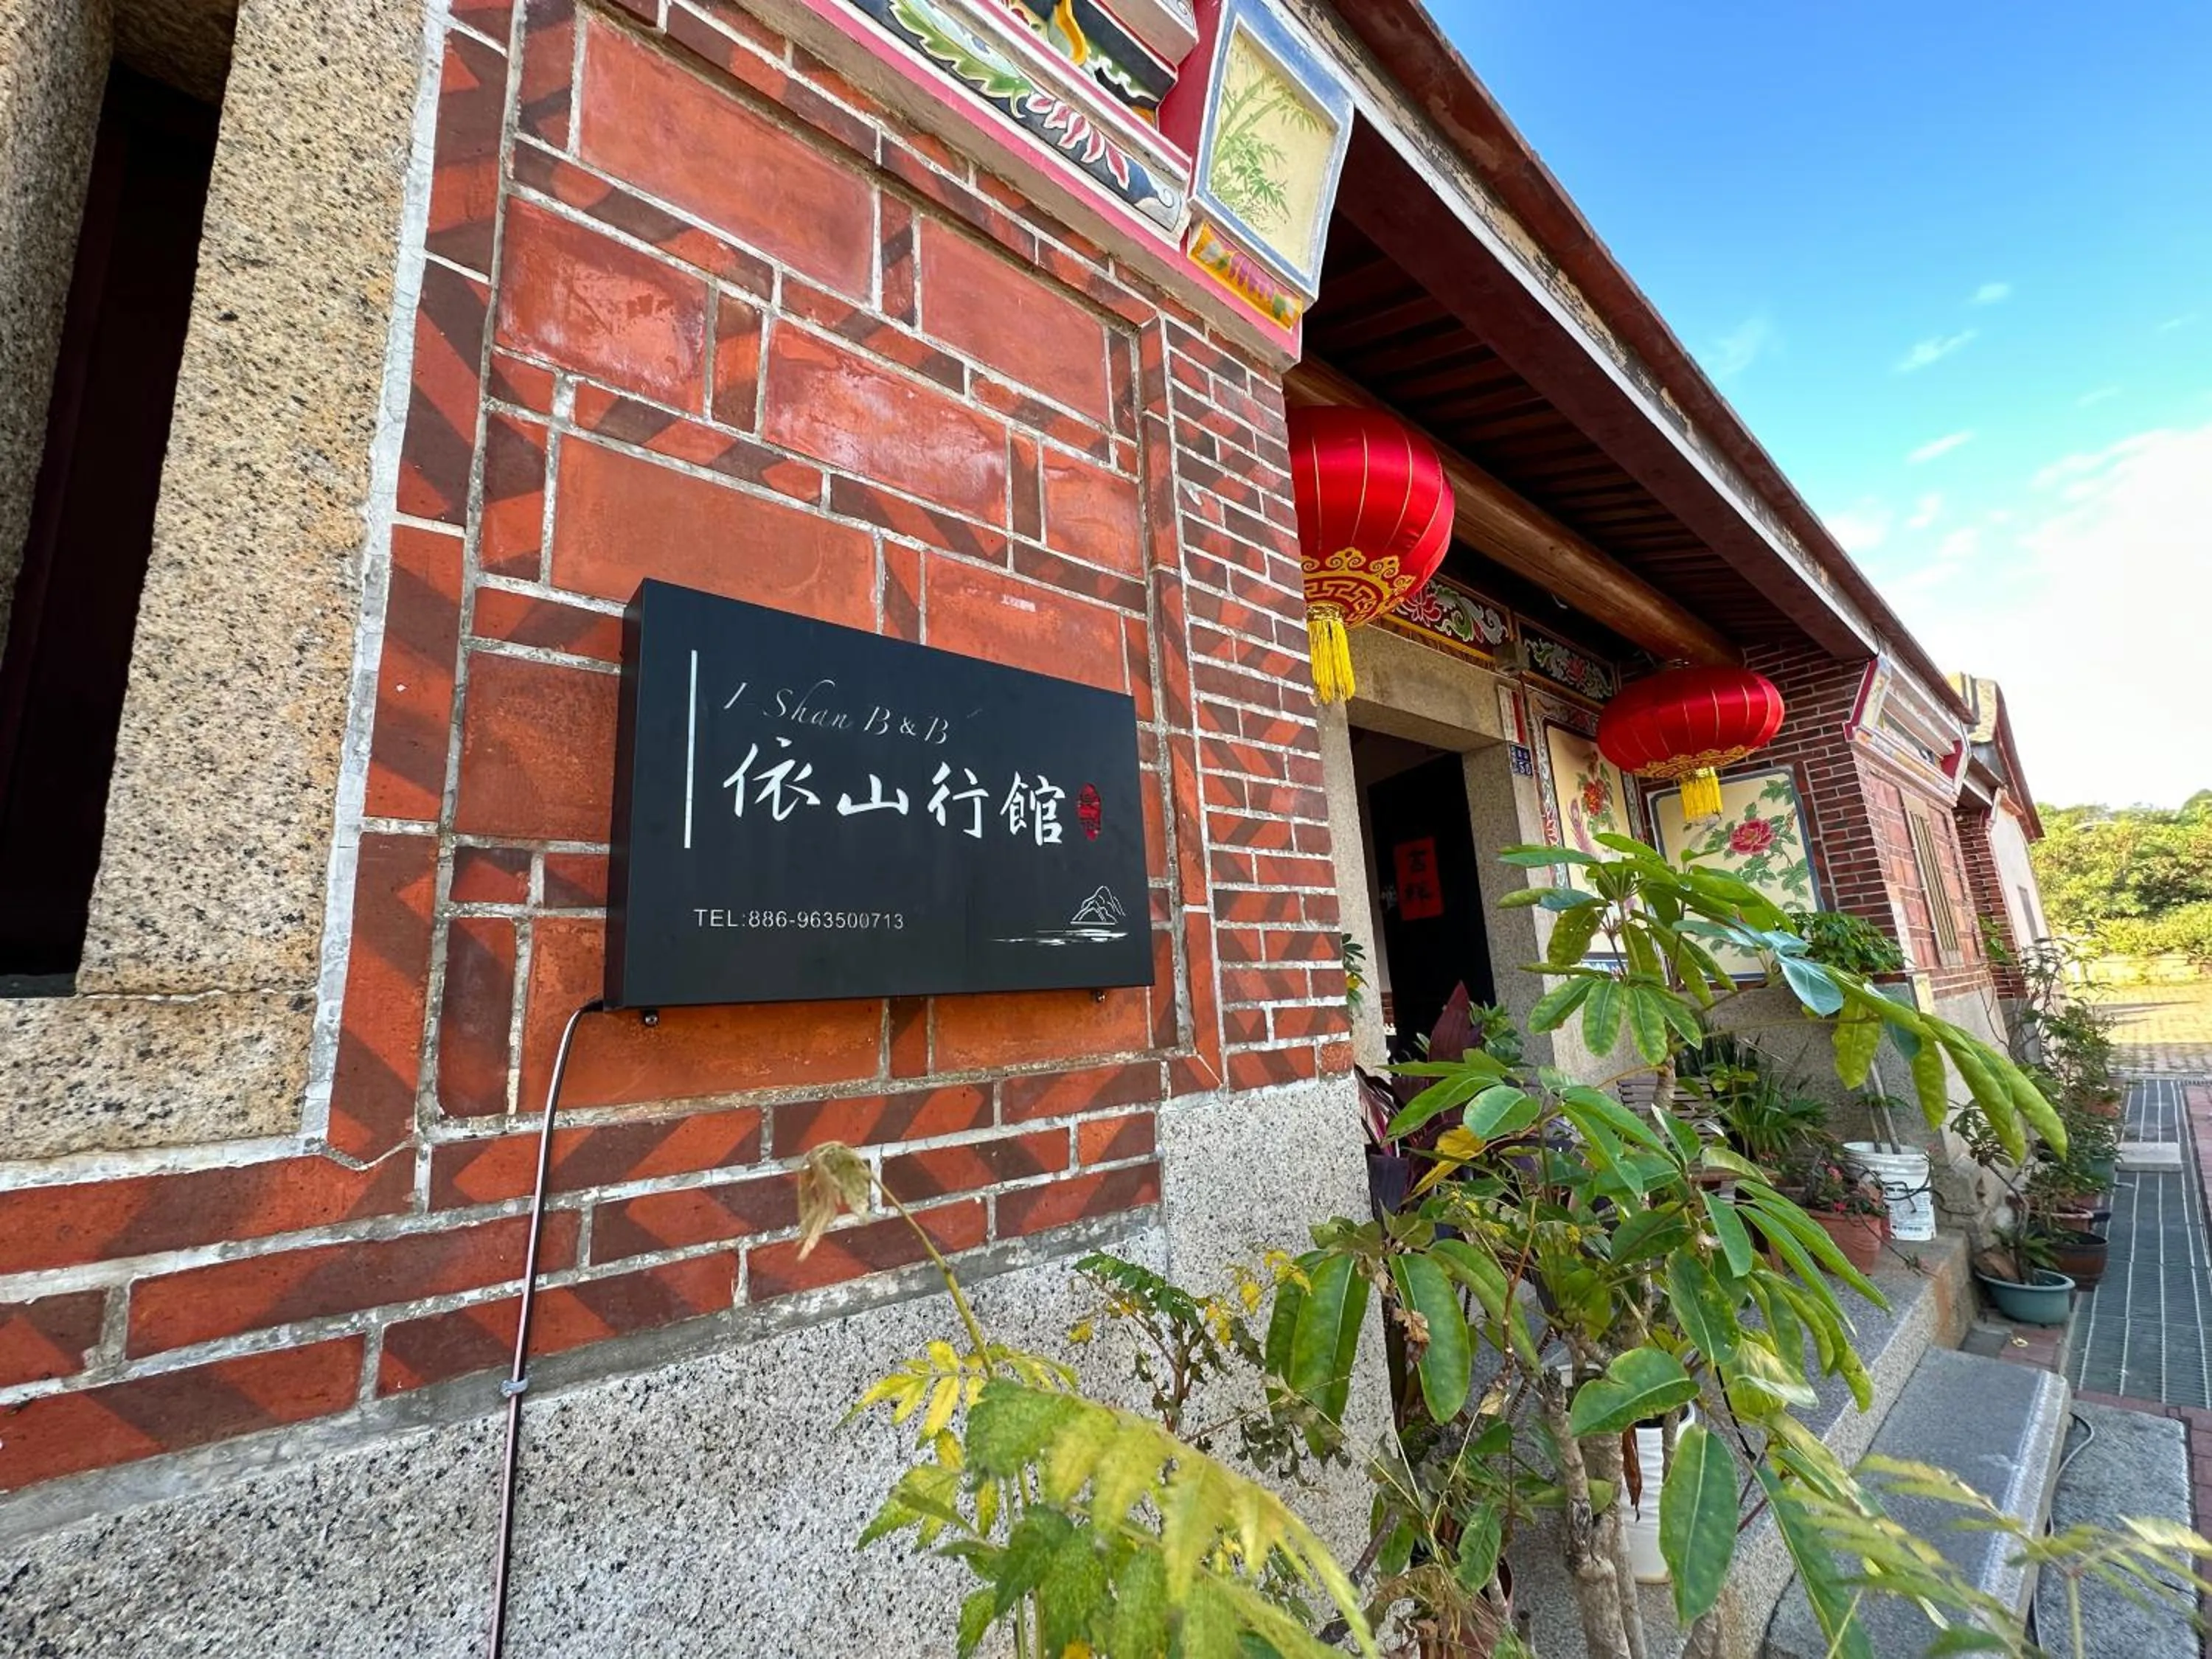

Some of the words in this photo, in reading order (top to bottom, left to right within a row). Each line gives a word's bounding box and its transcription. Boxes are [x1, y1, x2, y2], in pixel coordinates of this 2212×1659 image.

[723, 737, 1065, 846] 依山行館
[693, 908, 904, 930] TEL:886-963500713
